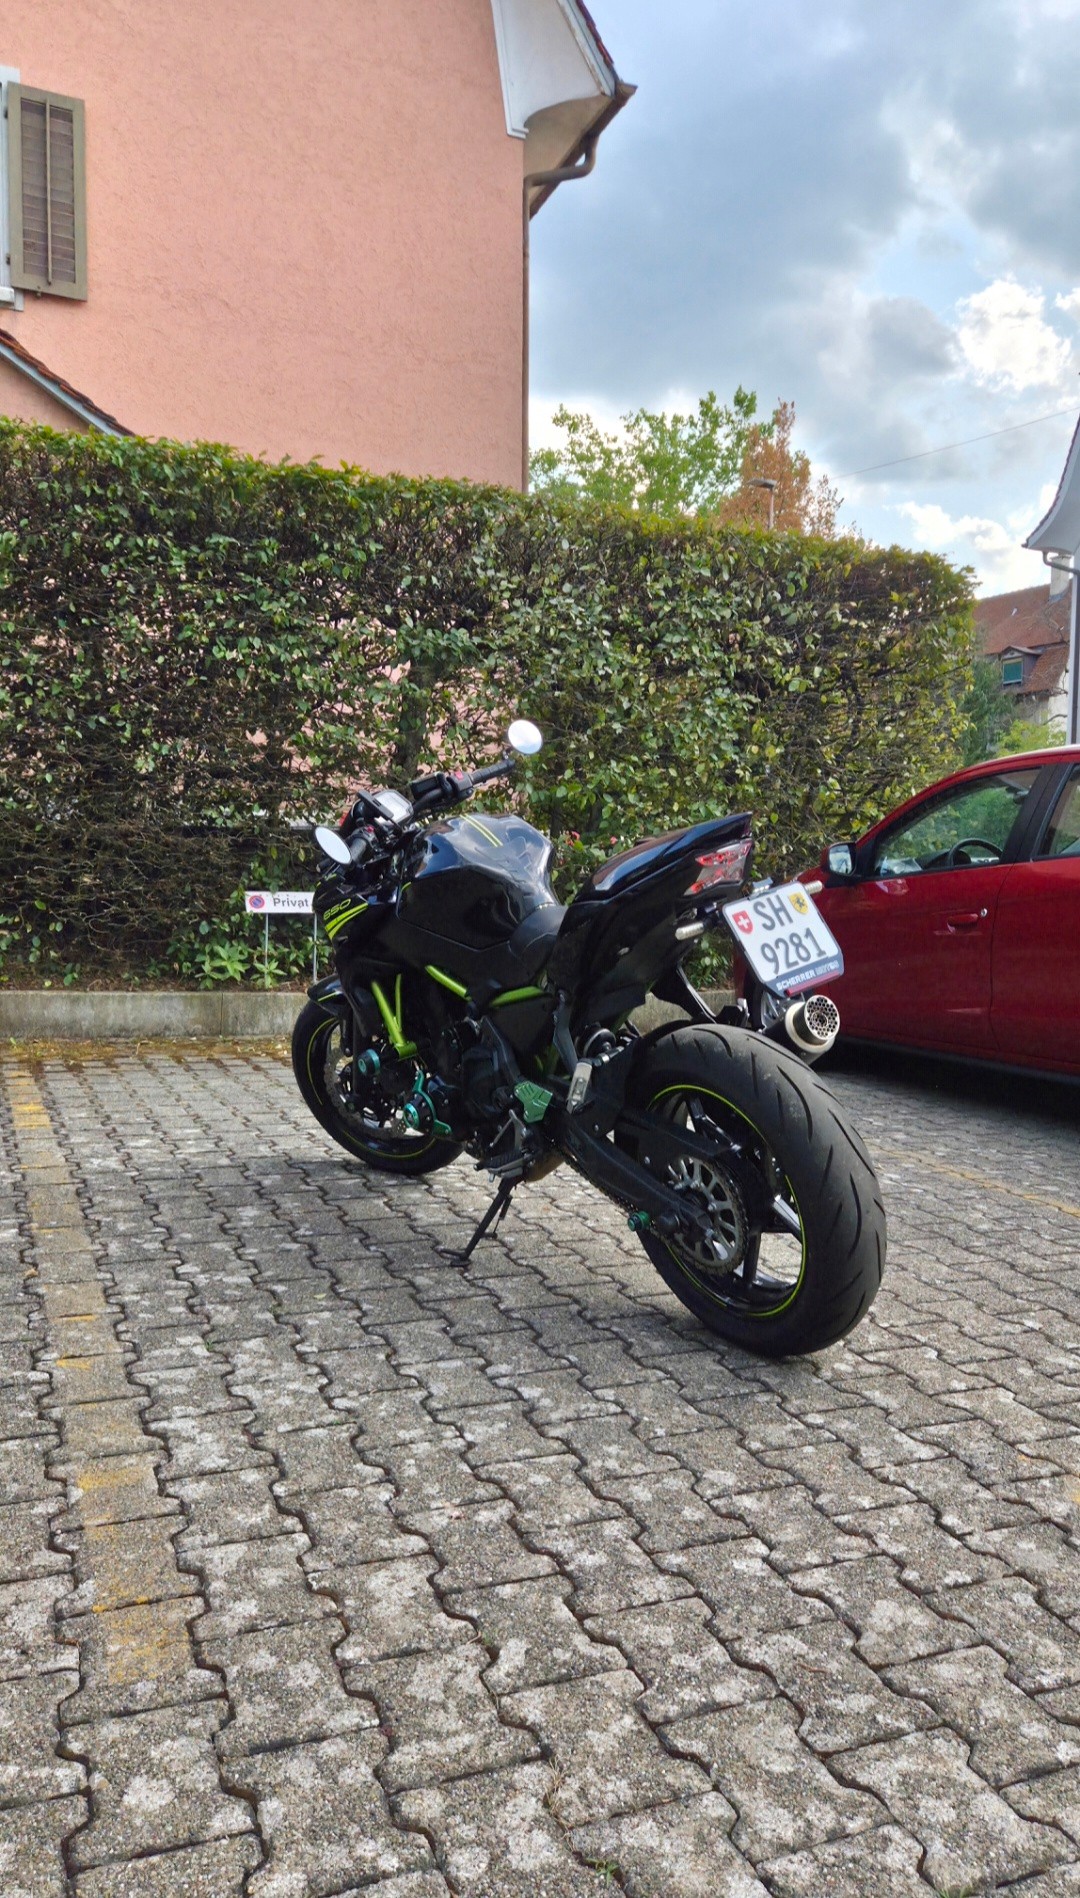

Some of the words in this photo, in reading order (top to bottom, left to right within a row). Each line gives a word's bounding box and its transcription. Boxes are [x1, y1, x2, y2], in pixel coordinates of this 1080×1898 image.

[273, 897, 309, 907] Privat
[323, 898, 351, 921] 650
[753, 894, 793, 930] SH
[761, 927, 826, 975] 9281
[776, 969, 816, 991] SCHERRER
